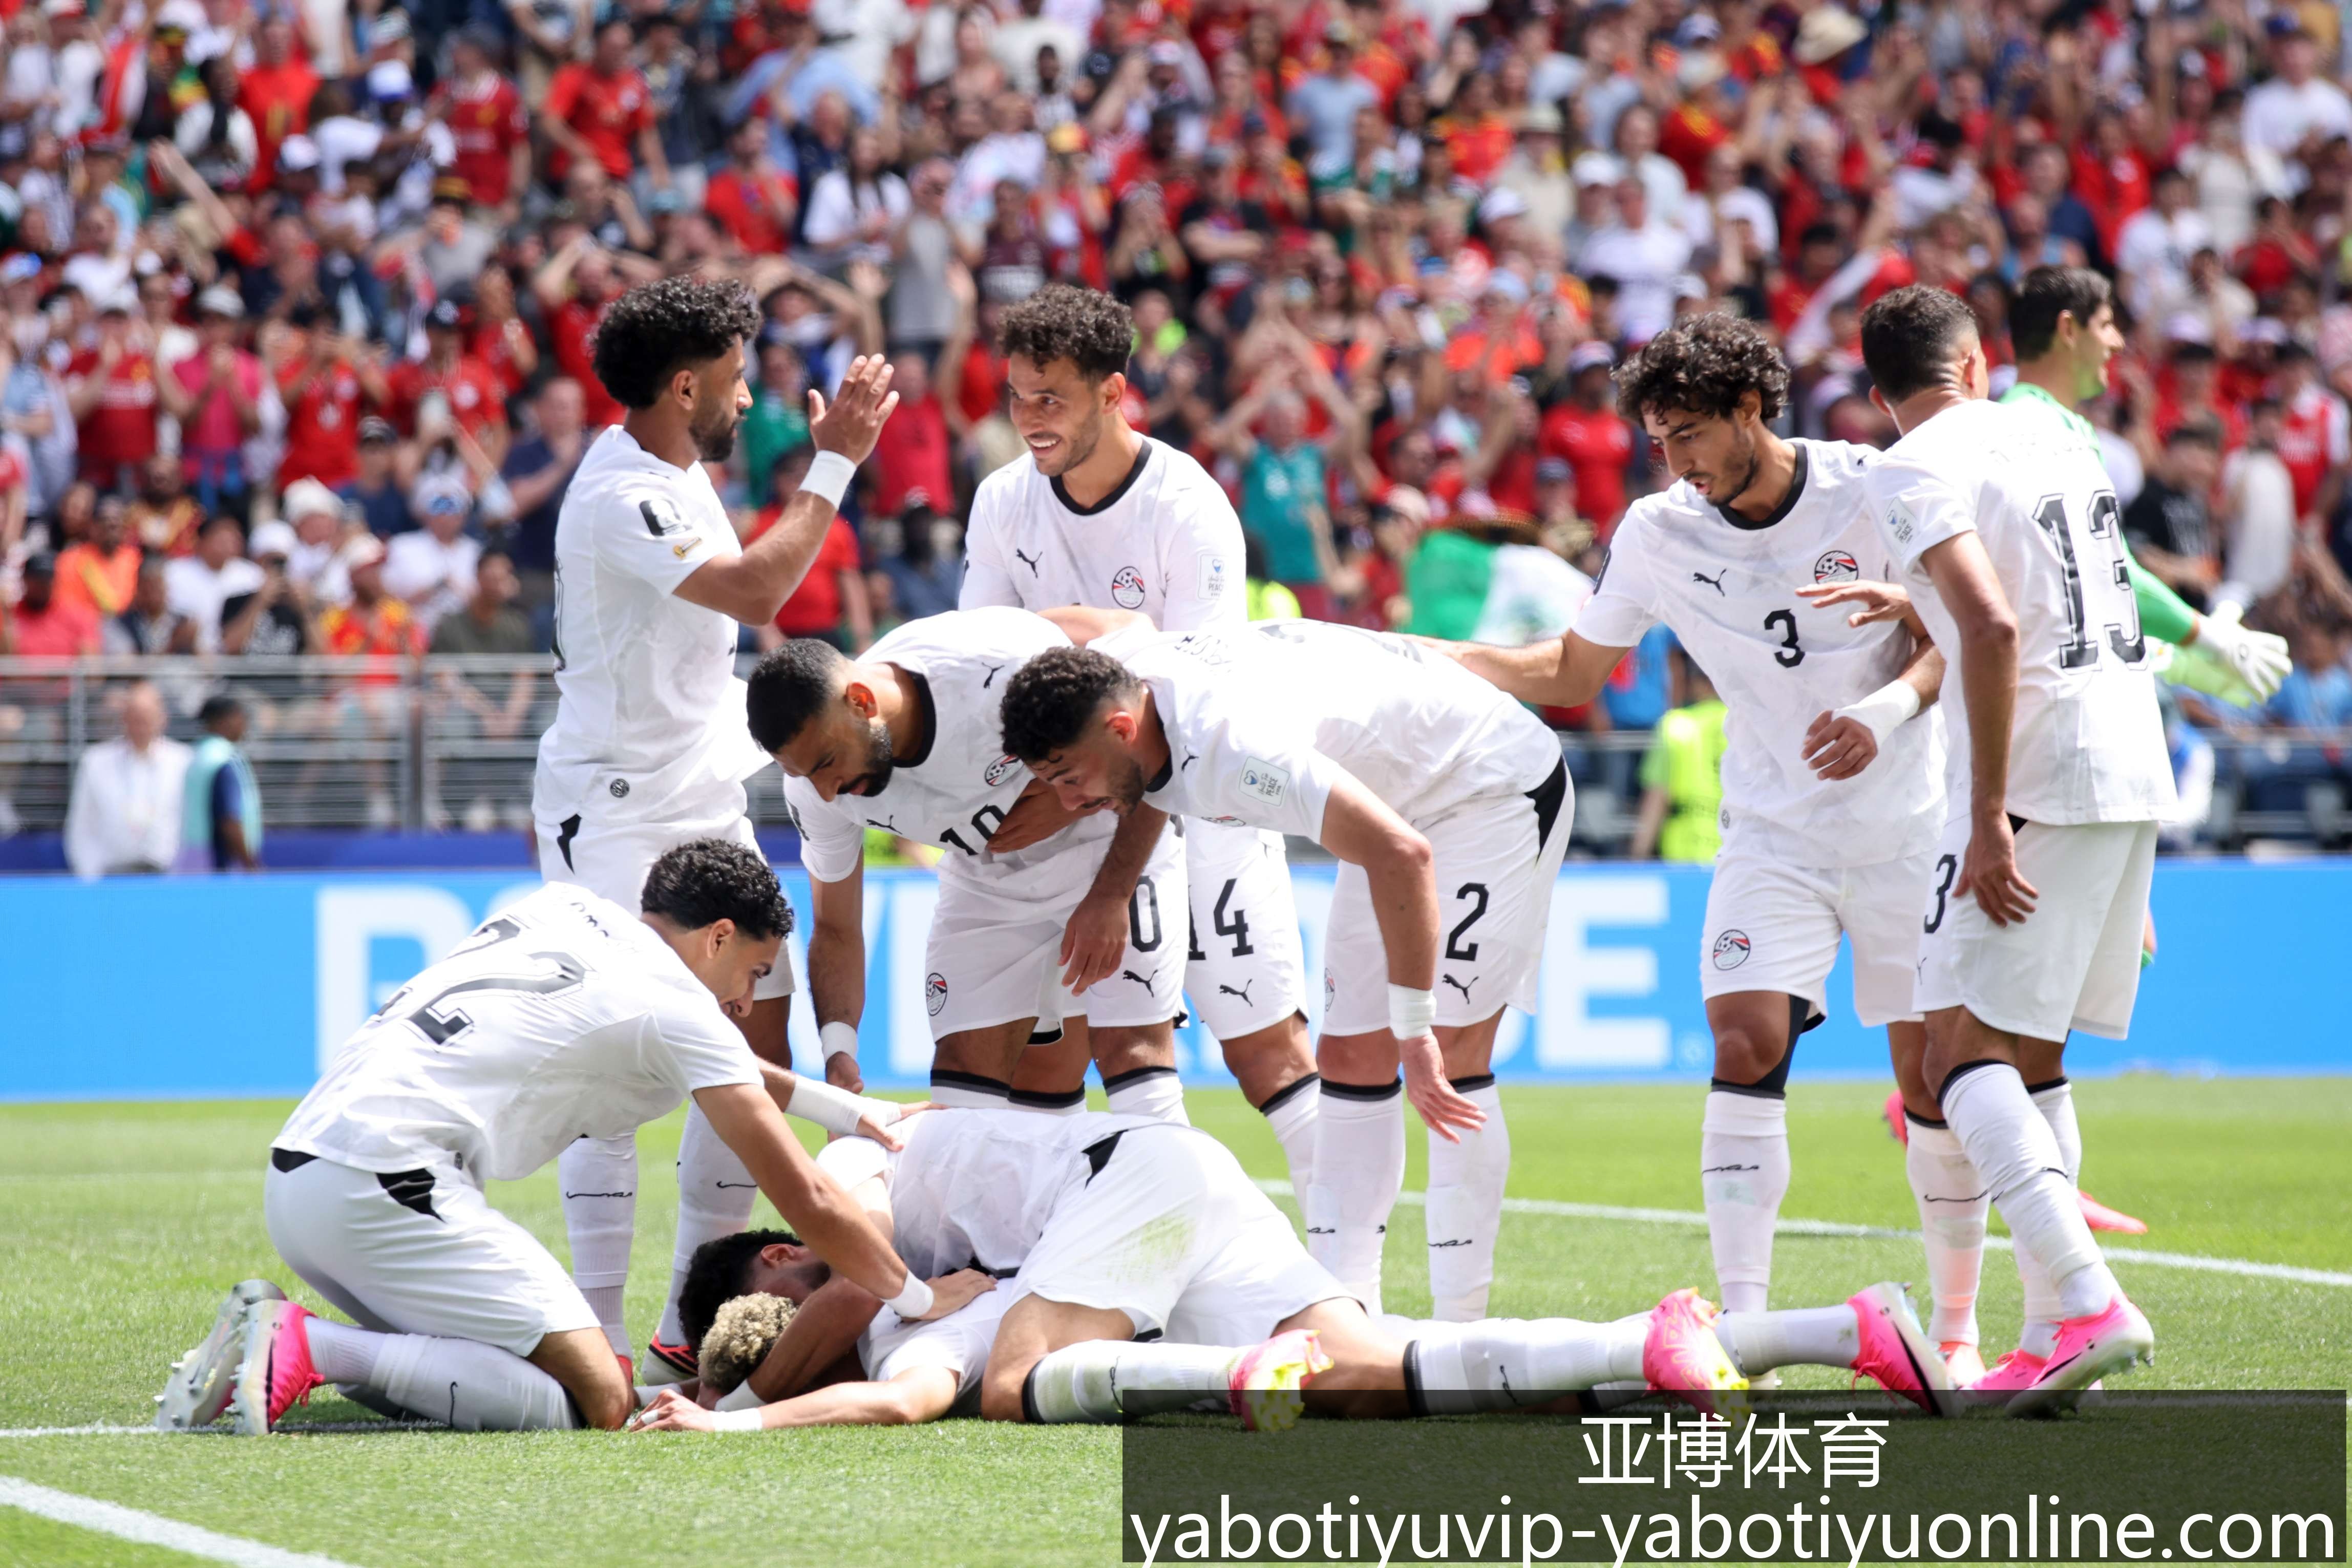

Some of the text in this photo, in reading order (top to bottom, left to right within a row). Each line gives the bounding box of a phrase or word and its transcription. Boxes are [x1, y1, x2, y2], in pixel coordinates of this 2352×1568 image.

[2032, 490, 2150, 674] 13
[1764, 608, 1806, 668] 3
[1266, 776, 1278, 796] PEACE
[1188, 878, 1254, 961] 14
[1445, 882, 1489, 961] 2
